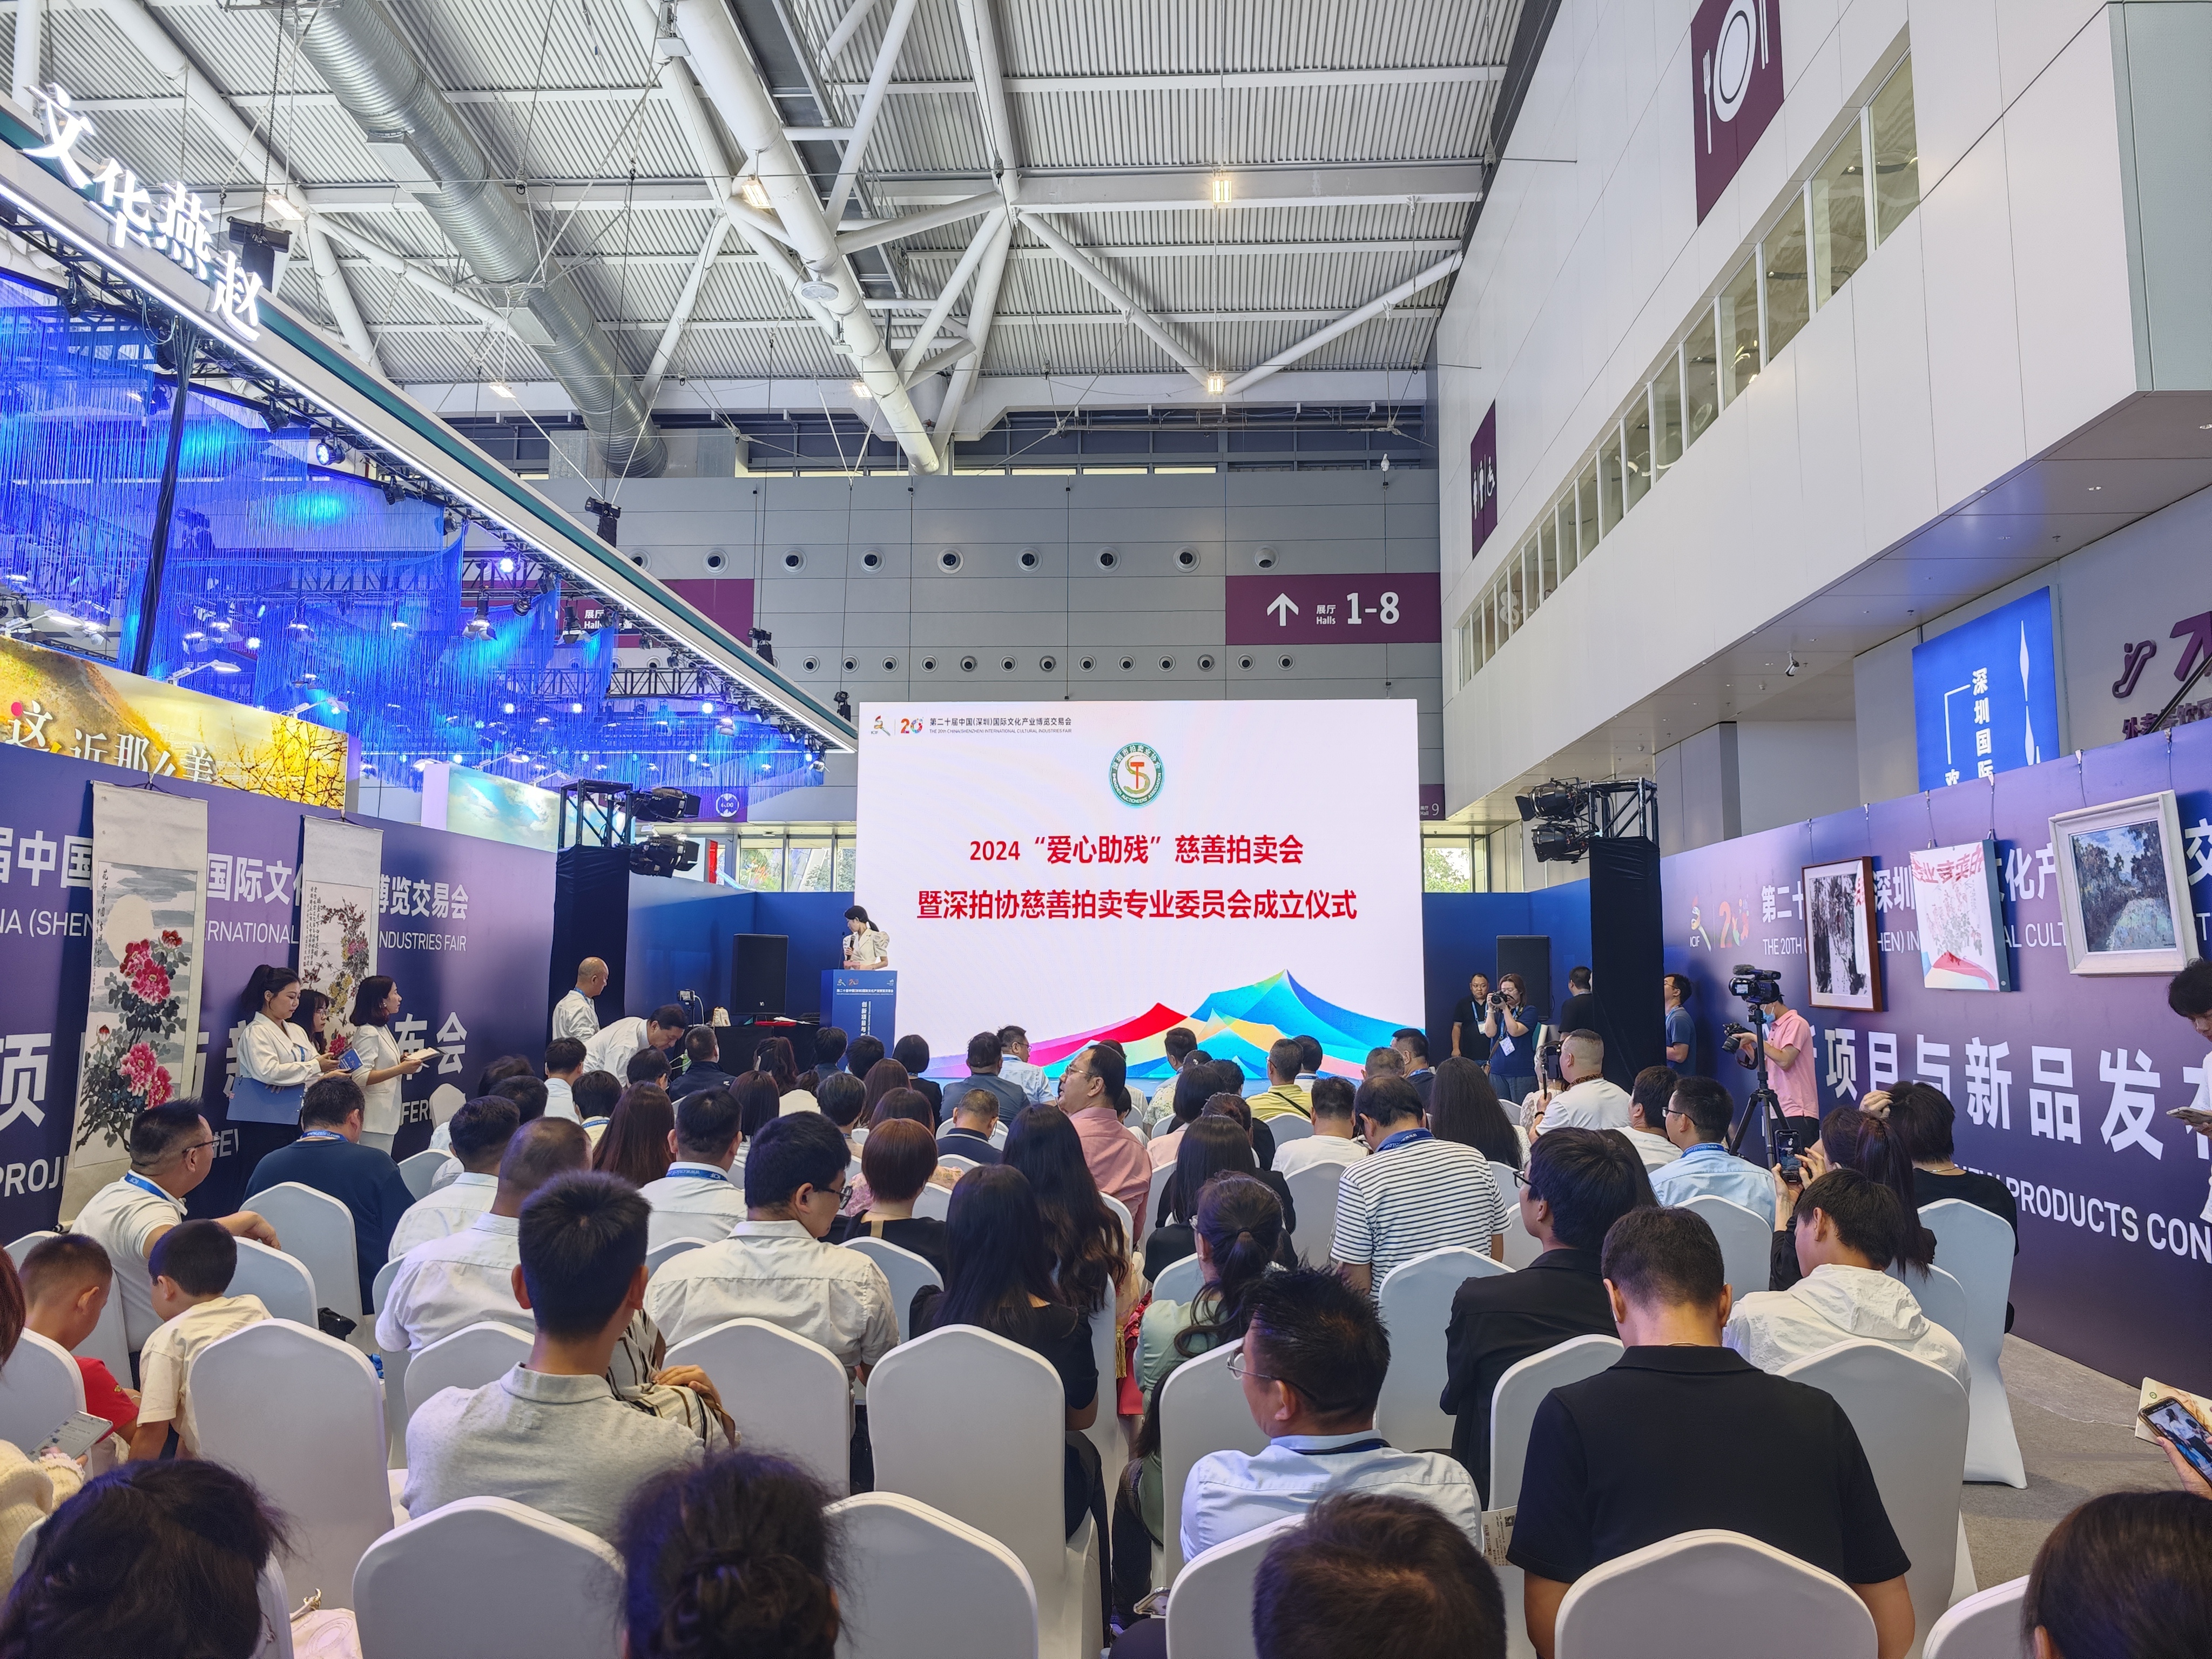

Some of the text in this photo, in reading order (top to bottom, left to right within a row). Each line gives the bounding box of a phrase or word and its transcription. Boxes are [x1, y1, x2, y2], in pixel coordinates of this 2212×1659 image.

[22, 82, 263, 341] 文华燕赵
[1316, 604, 1336, 615] 展厅
[1346, 591, 1400, 625] 1-8
[1316, 616, 1336, 625] Halls
[1432, 803, 1439, 816] 9
[917, 889, 1358, 919] 暨深拍协慈善拍卖专业委员会成立仪式
[444, 934, 466, 952] FAIR
[1690, 936, 1701, 947] ICIF
[1763, 938, 1779, 955] THE
[1781, 936, 1802, 955] 20TH
